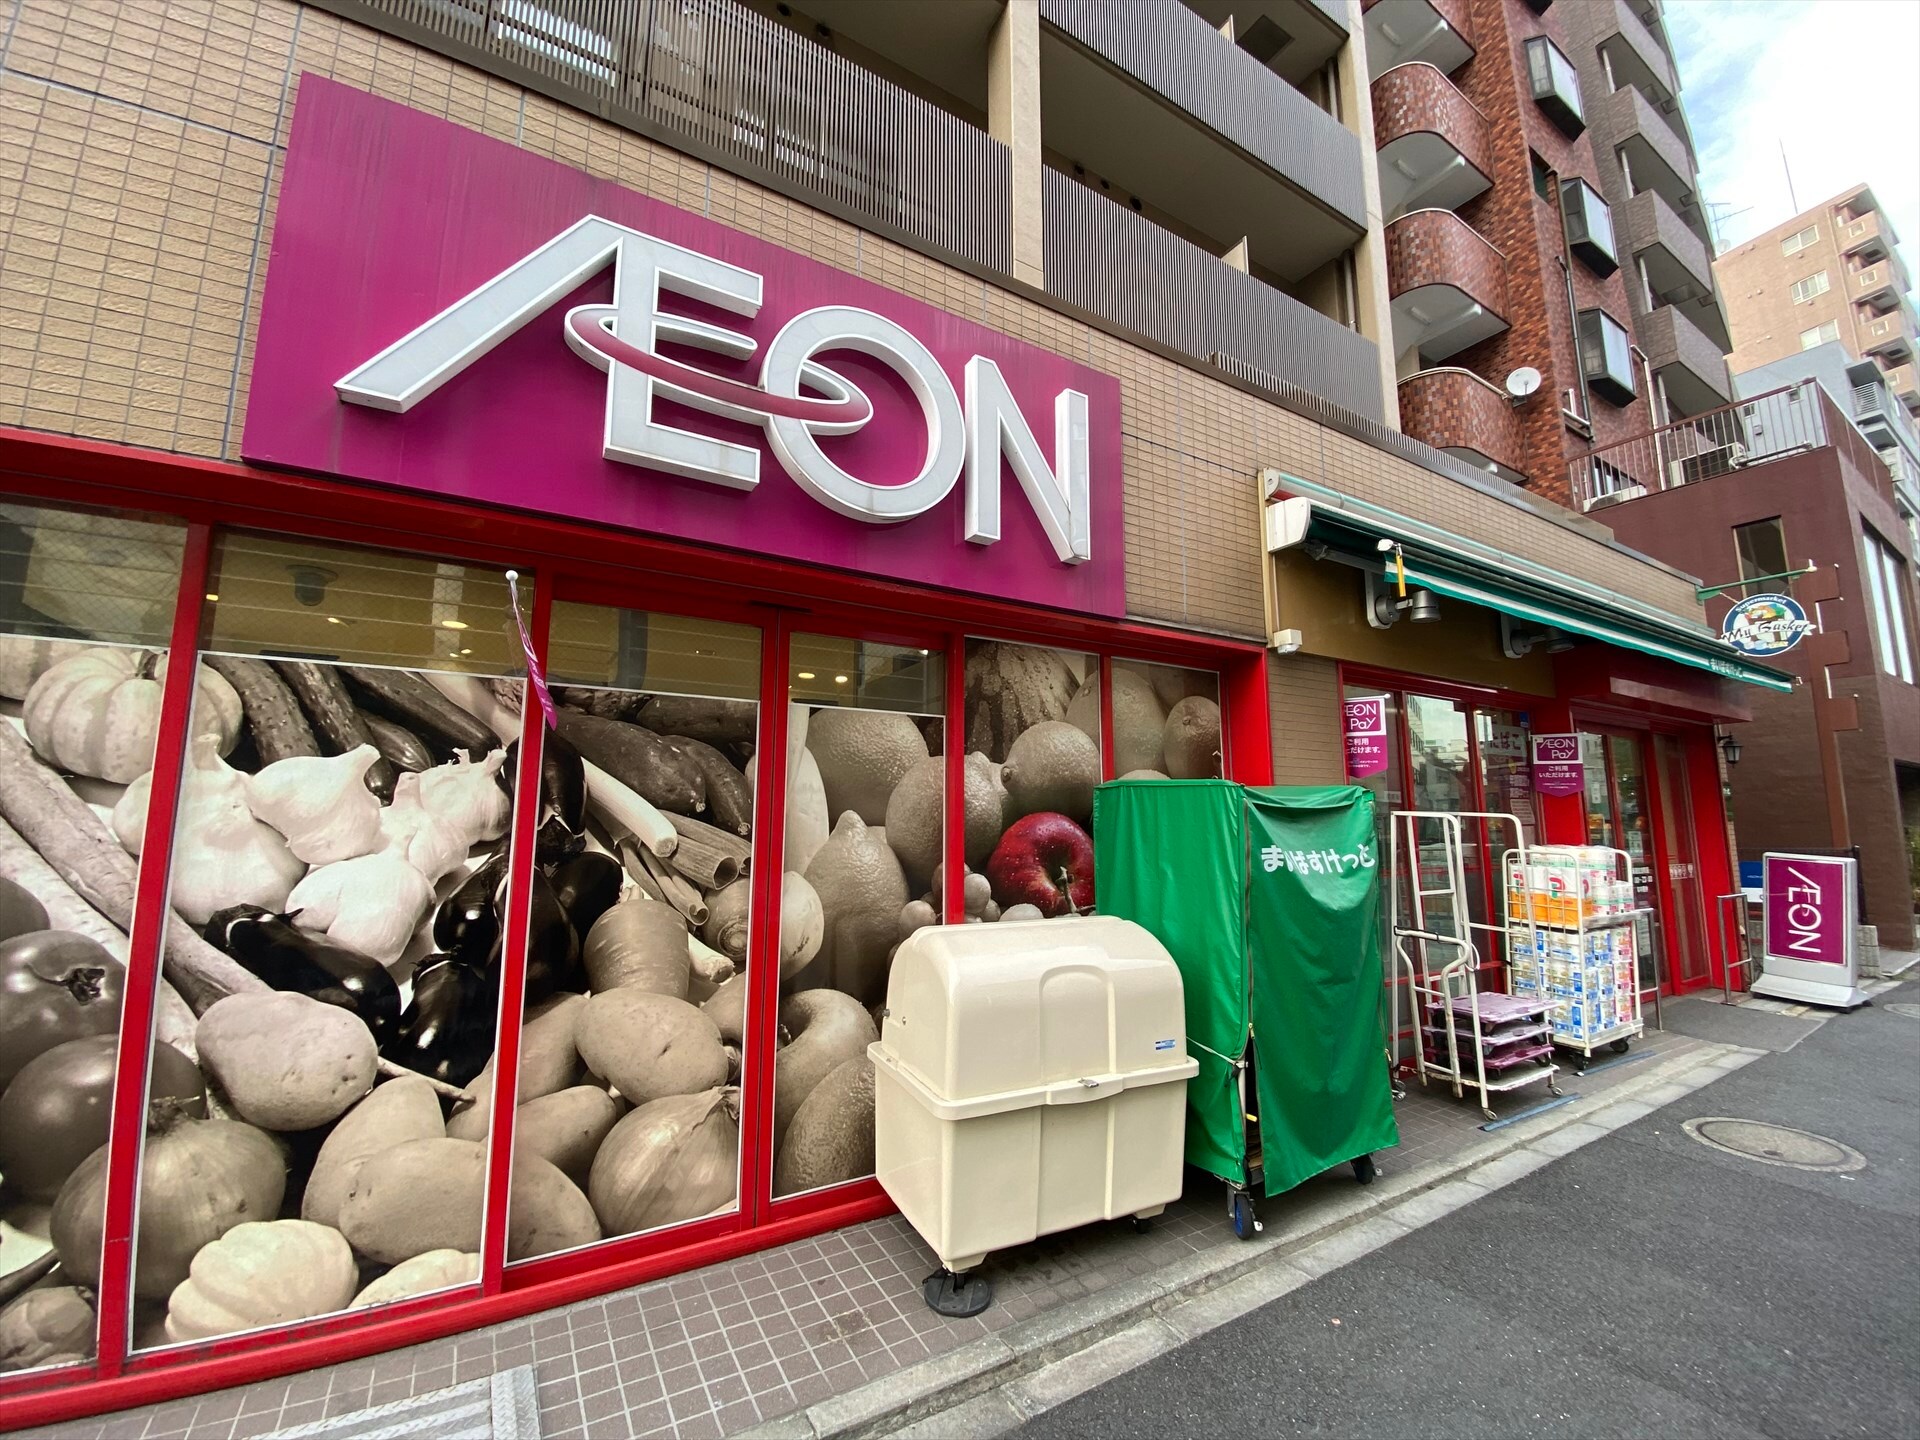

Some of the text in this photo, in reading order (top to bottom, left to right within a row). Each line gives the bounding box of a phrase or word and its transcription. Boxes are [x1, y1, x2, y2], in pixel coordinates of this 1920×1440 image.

[1735, 596, 1787, 613] Supermarket
[1721, 619, 1808, 643] My Basket
[1345, 703, 1377, 717] EON
